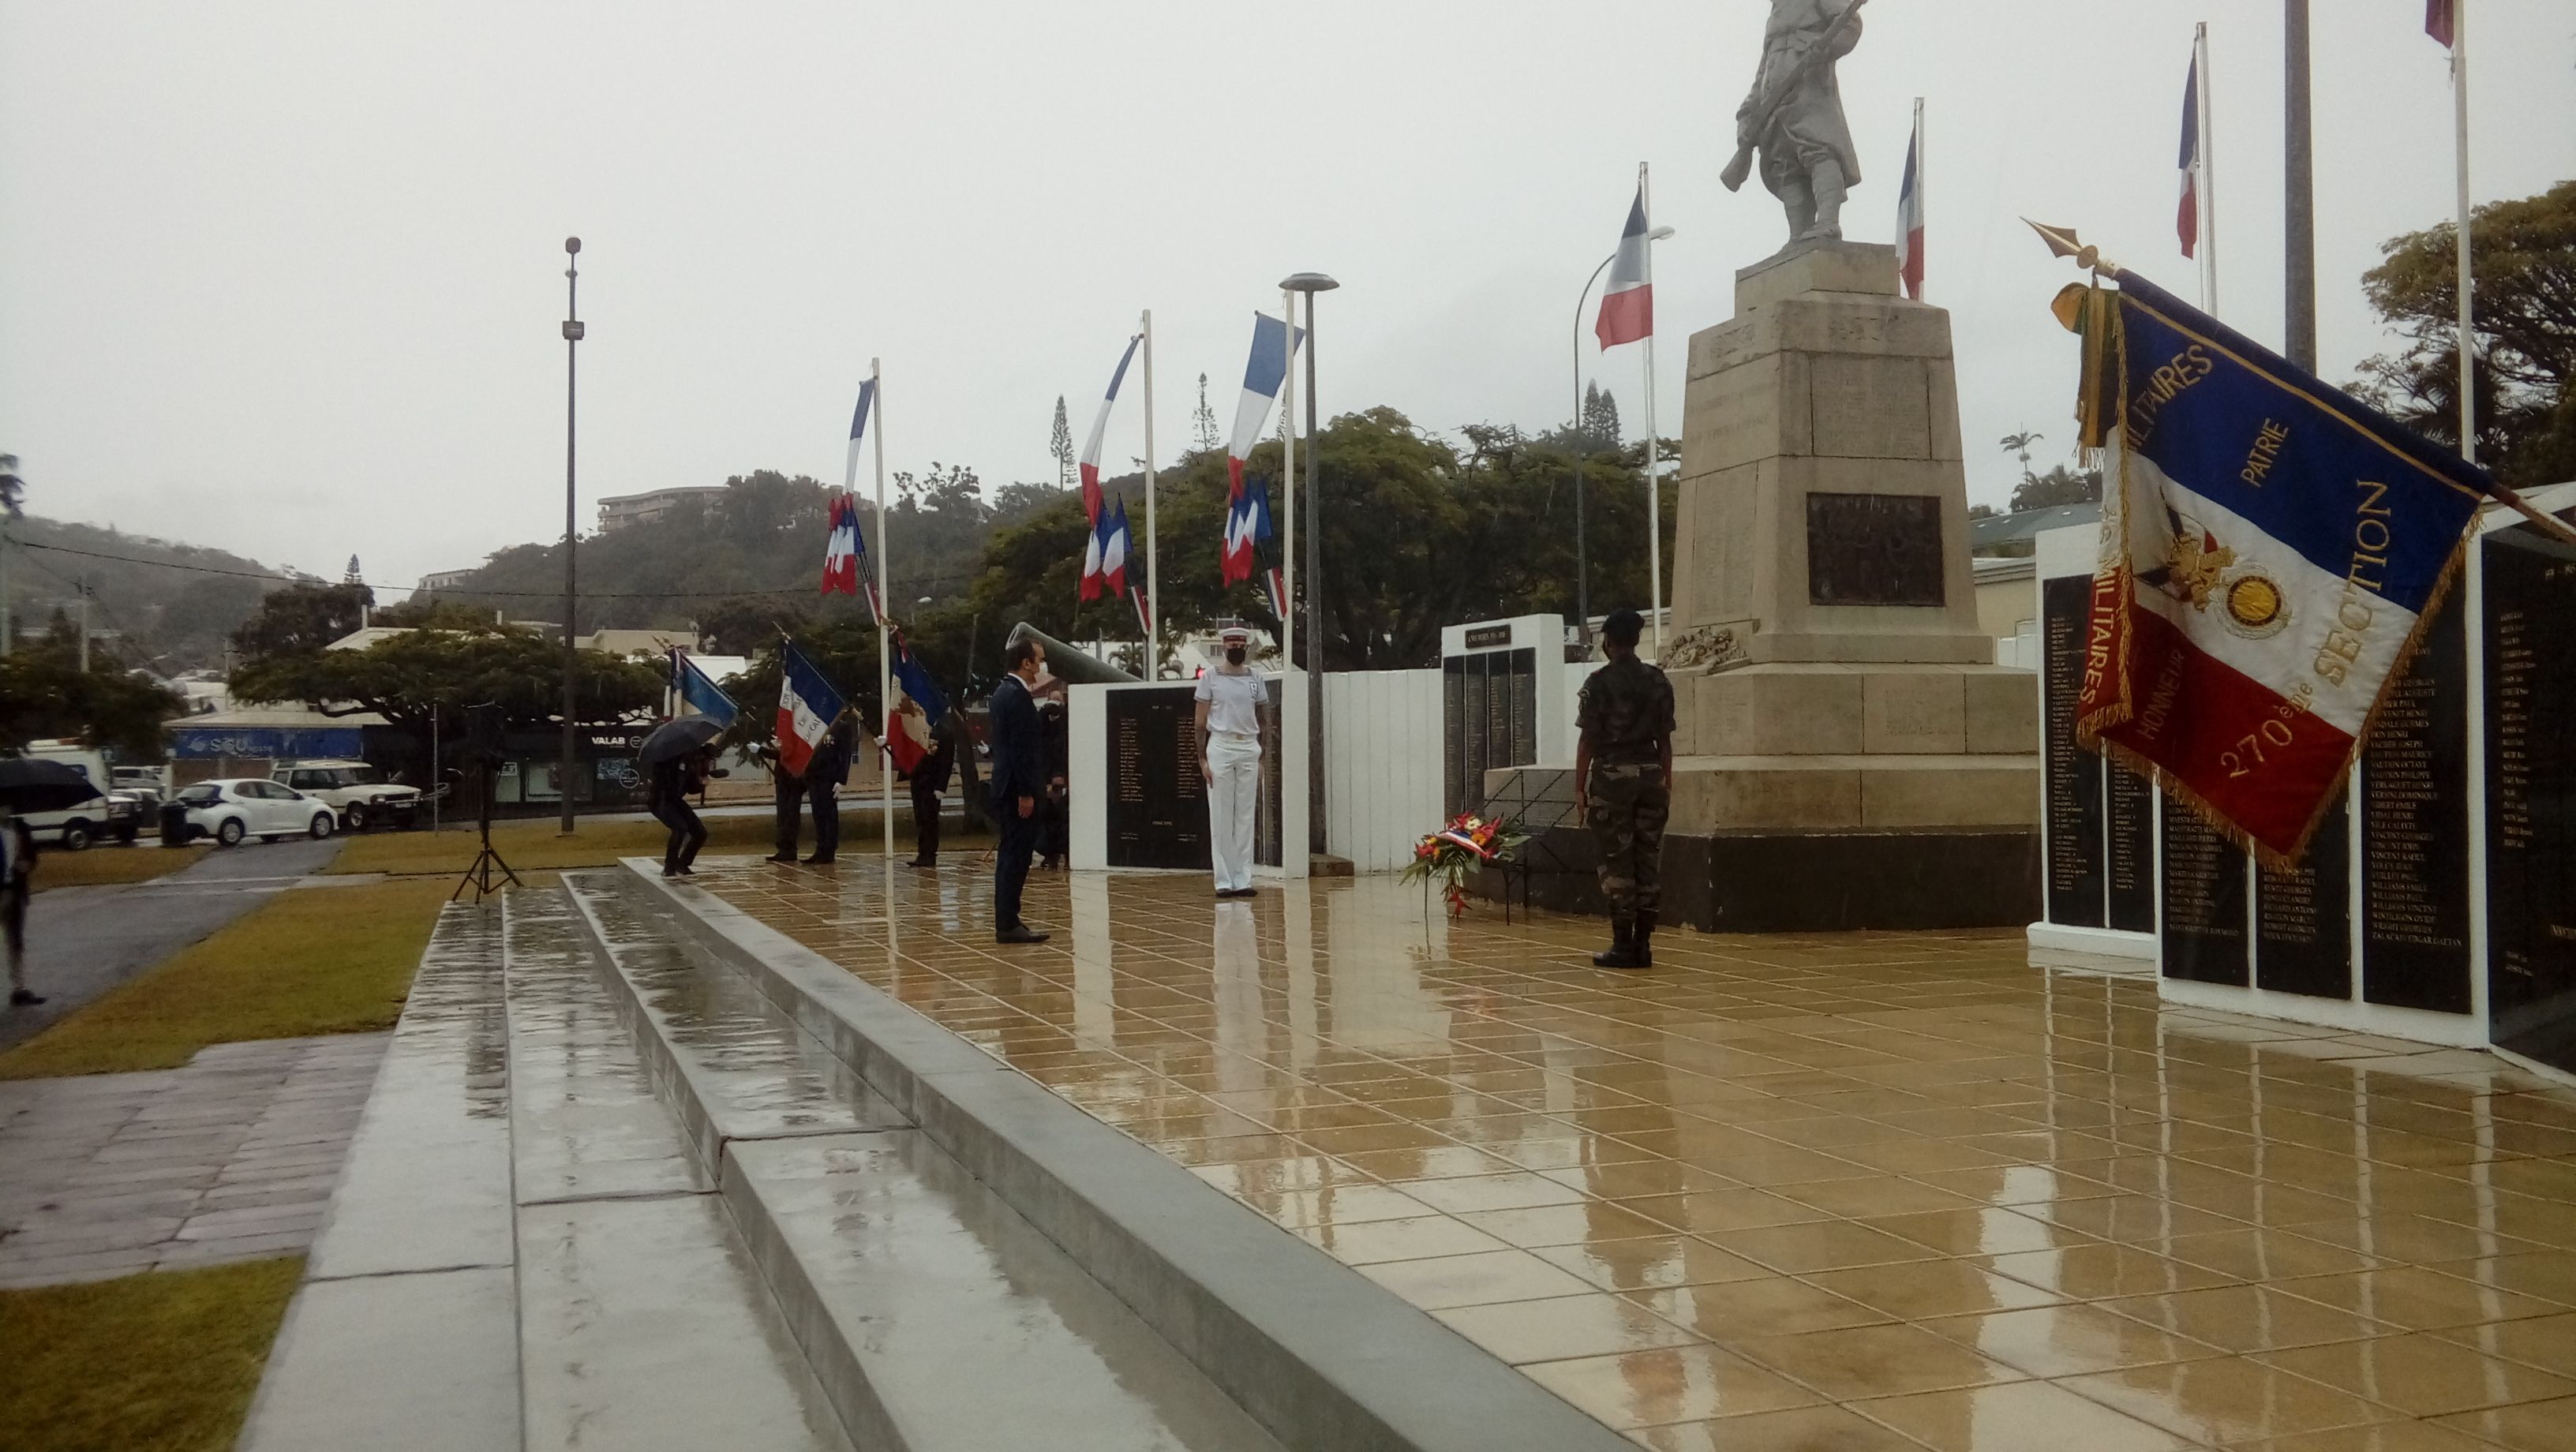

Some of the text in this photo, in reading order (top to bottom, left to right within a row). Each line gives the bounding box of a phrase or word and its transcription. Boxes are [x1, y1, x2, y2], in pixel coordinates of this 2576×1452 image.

[2241, 417, 2289, 488] PATRIE
[2313, 479, 2391, 687] SECTION
[2080, 554, 2118, 705] MILITAIRES
[2135, 648, 2185, 739] HONNEUR
[592, 736, 625, 745] VALAB
